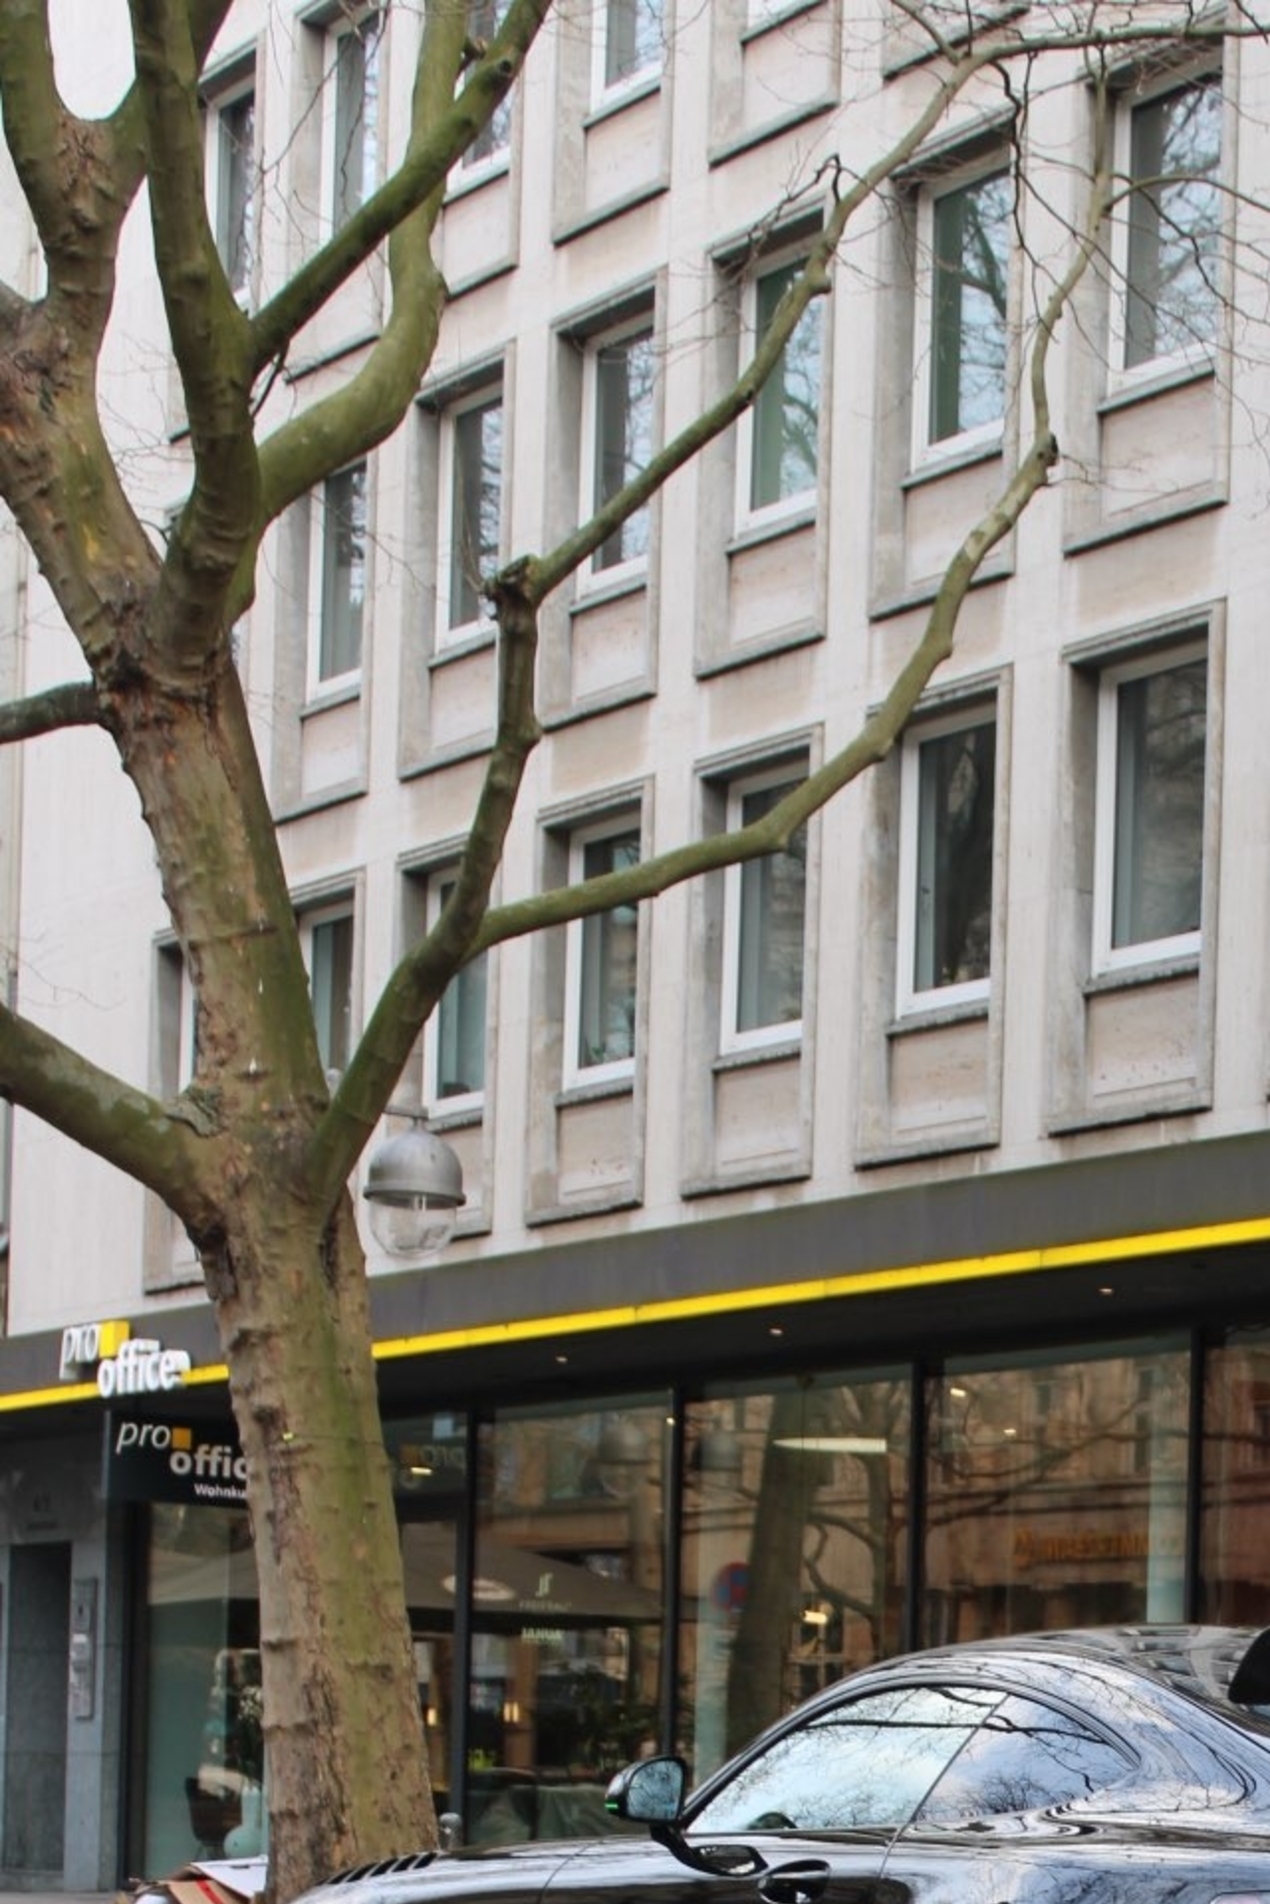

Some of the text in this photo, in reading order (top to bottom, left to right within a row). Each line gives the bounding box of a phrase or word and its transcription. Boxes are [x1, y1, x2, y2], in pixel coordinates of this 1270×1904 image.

[59, 1323, 101, 1380] pro
[96, 1337, 190, 1398] office
[115, 1419, 171, 1454] pro
[169, 1443, 248, 1480] offic
[193, 1483, 248, 1500] Wohnku
